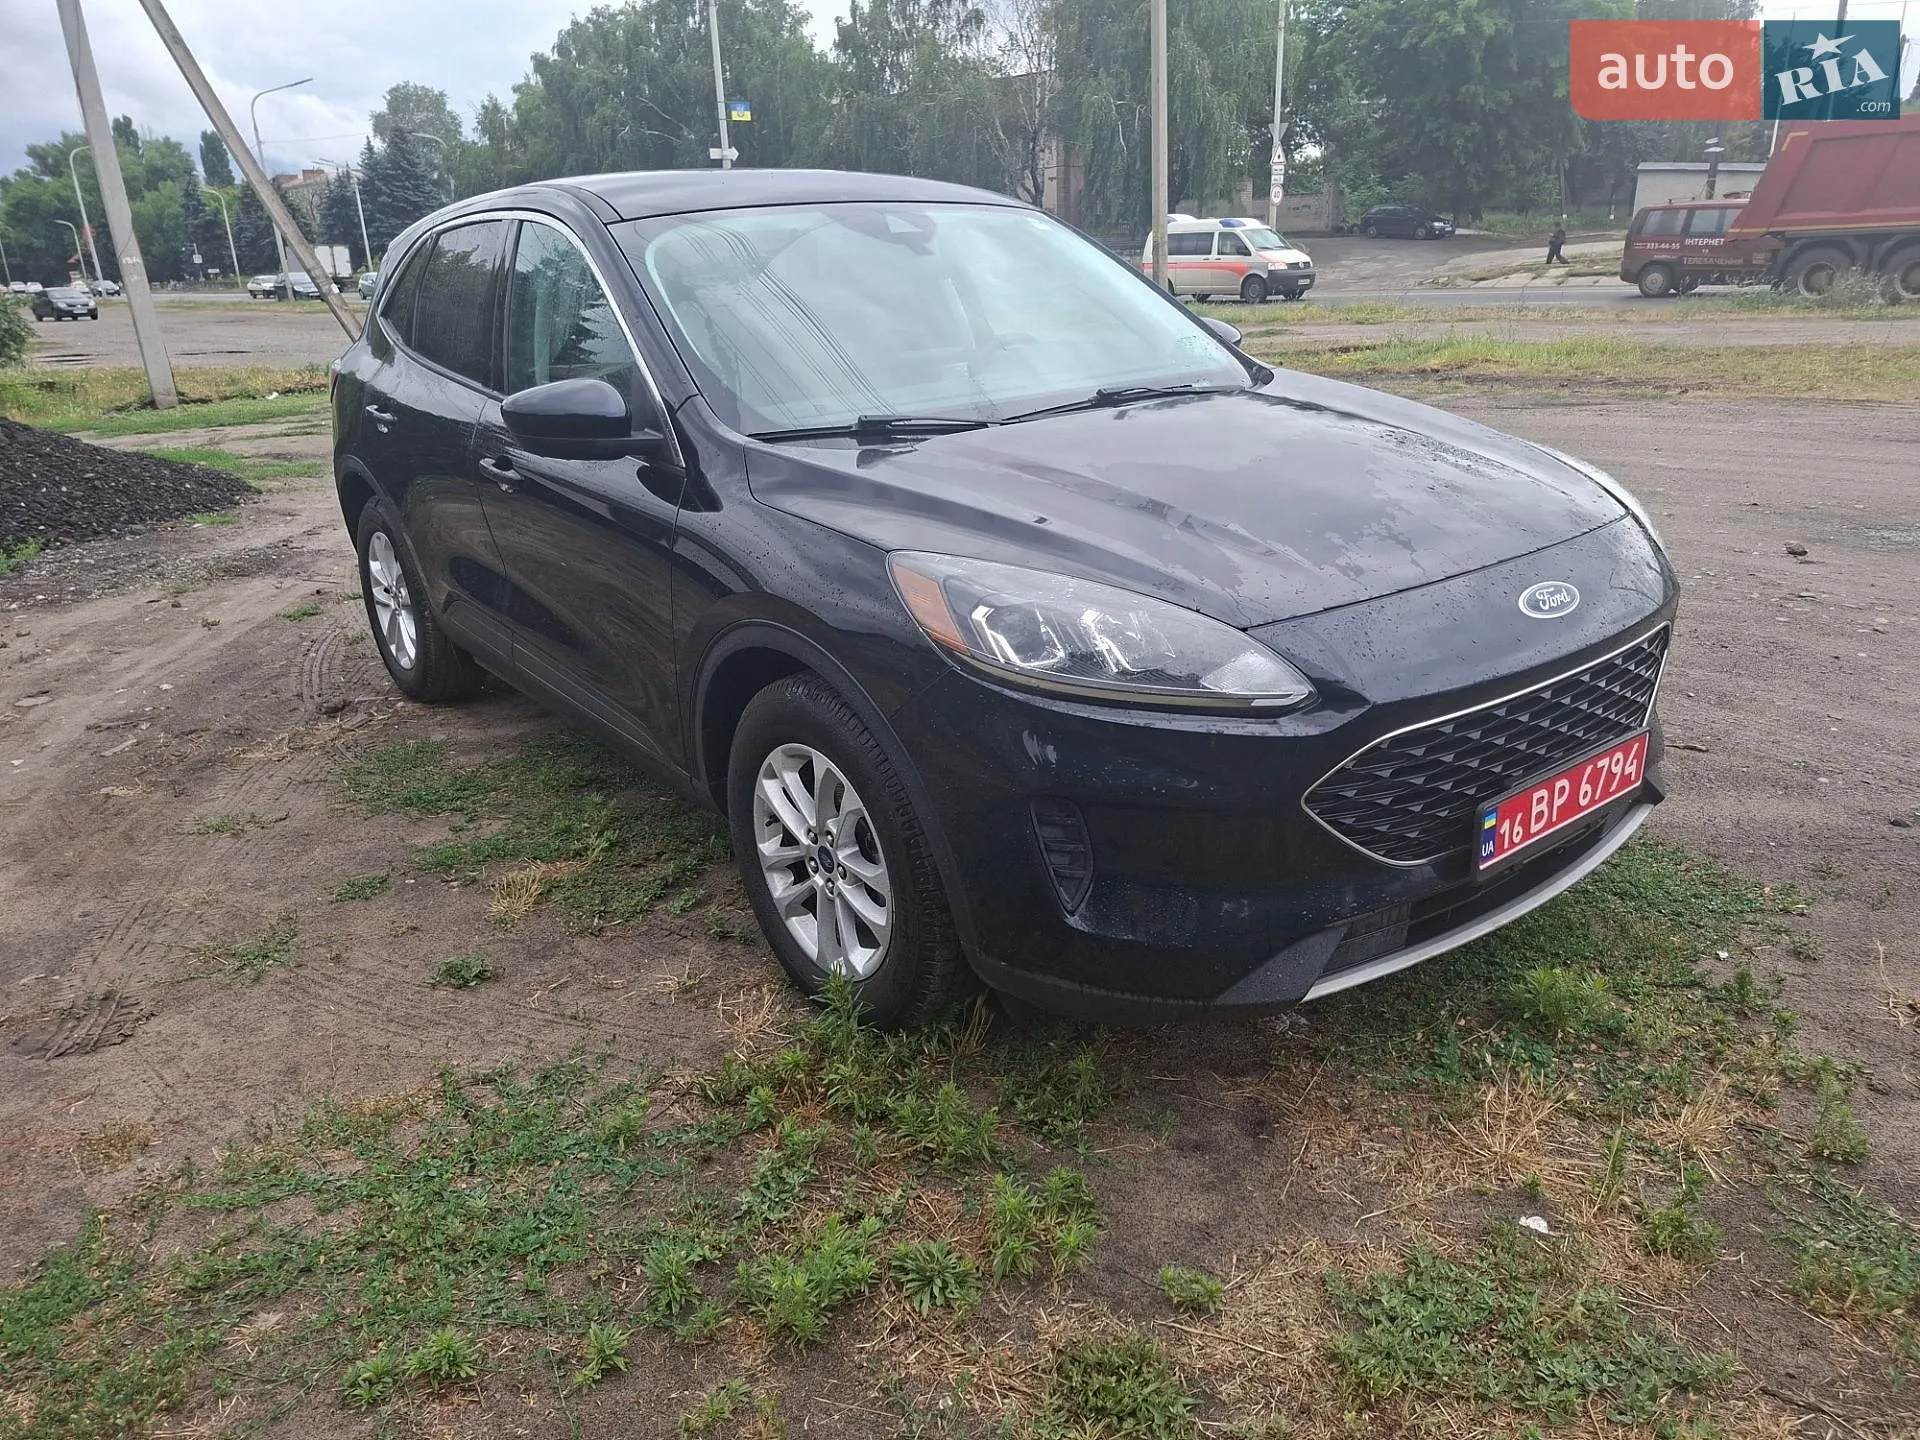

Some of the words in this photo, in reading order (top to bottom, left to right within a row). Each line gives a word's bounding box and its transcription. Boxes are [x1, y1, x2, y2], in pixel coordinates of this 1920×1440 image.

[1685, 238, 1724, 246] ІНТЕРНЕТ
[1536, 587, 1570, 610] Ford
[1500, 812, 1523, 849] 16
[1579, 743, 1639, 806] 6794
[1482, 841, 1494, 857] UA
